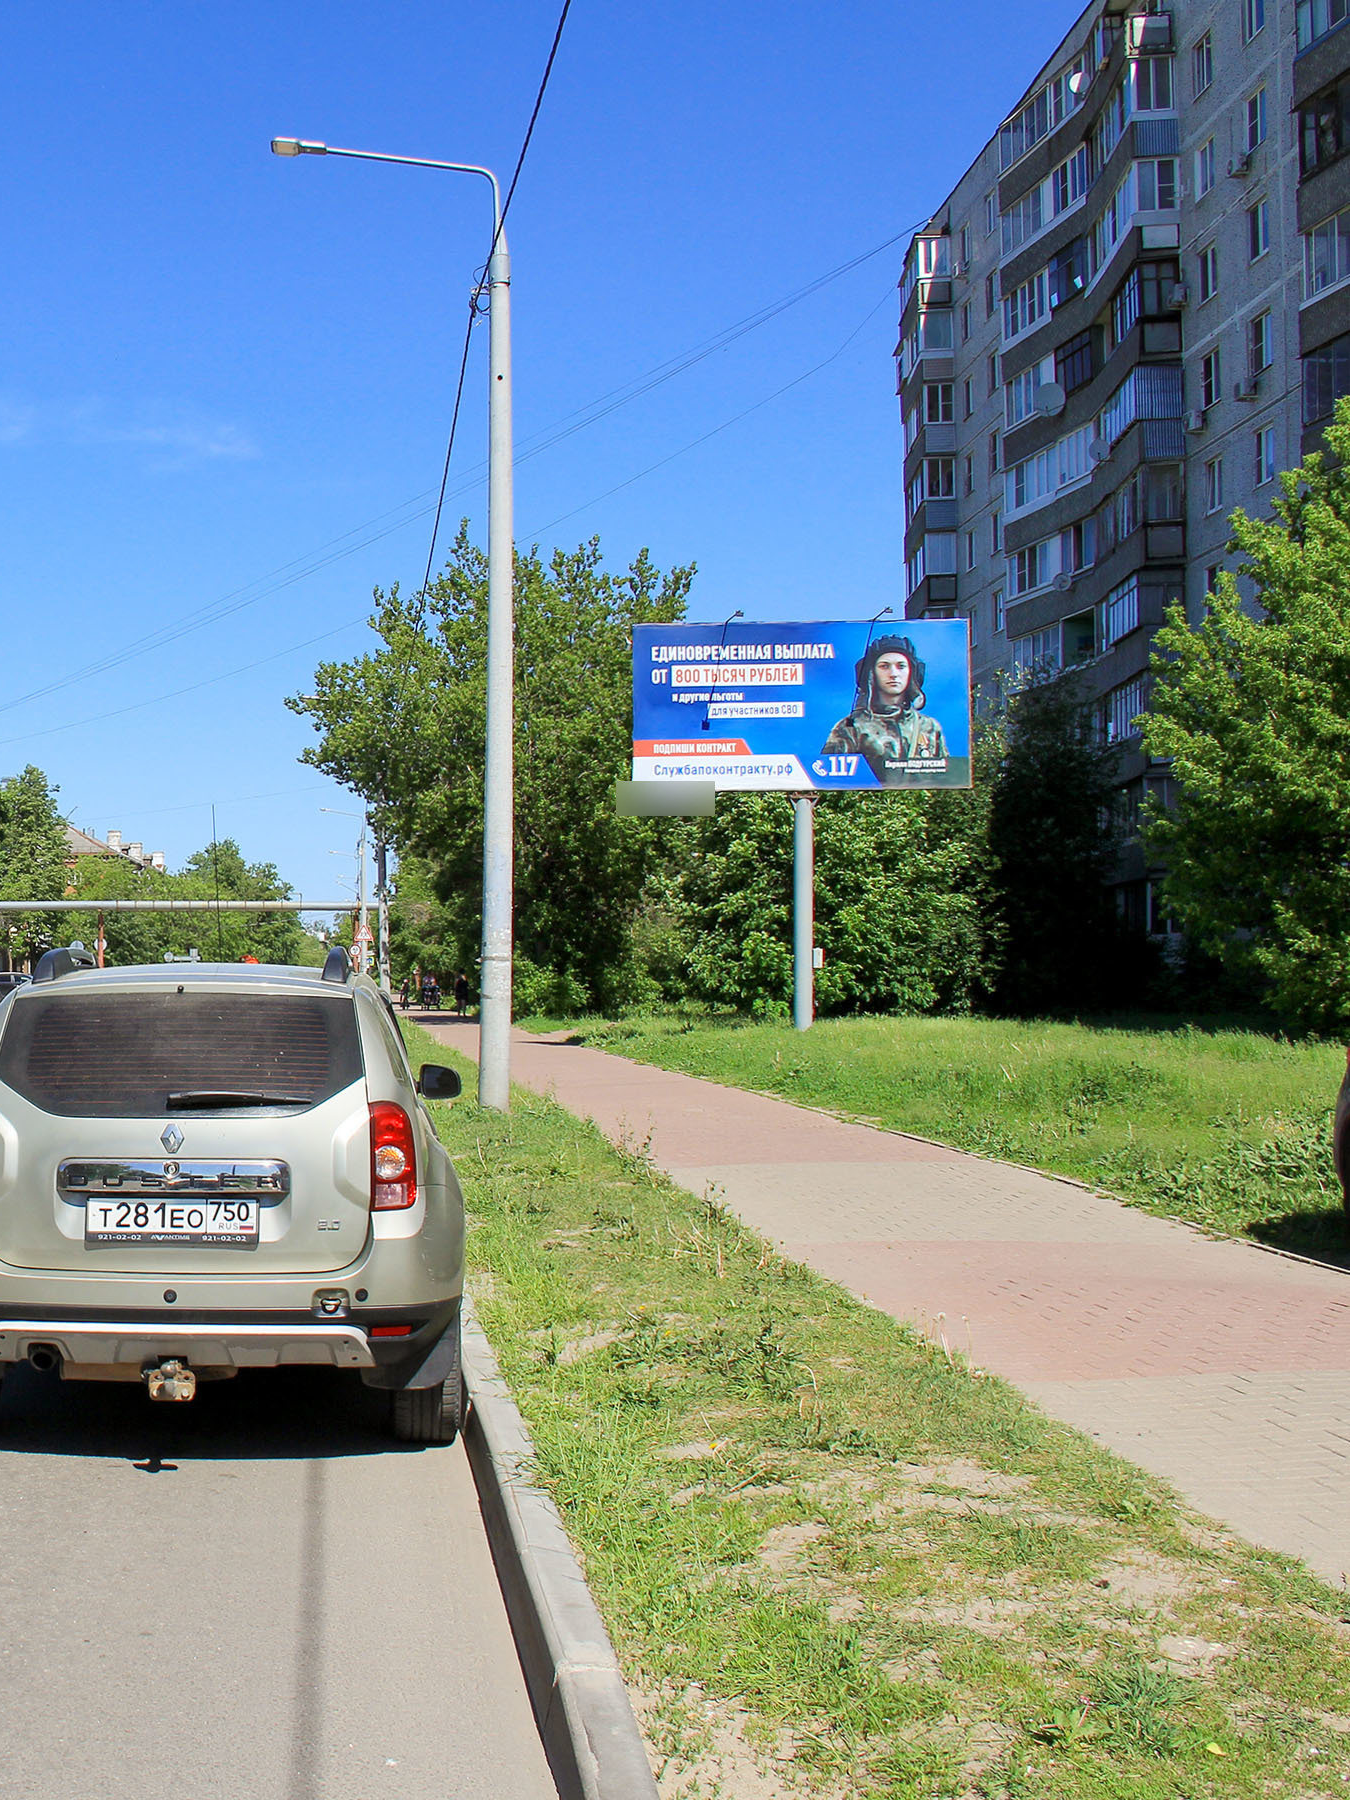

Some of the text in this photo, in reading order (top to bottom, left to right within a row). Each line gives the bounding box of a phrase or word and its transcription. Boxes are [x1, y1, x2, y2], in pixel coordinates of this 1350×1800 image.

[651, 643, 834, 663] ЕДИНОВРЕМЕННАЯ ВЫПЛАТА
[651, 665, 798, 684] ОТ 800 ТЫСЯЧ РУБЛЕЙ
[672, 692, 743, 704] и другие льготы
[711, 704, 798, 717] для участников СВО
[653, 742, 737, 755] ПОДПИШИ КОНТРАКТ
[653, 762, 793, 777] Службапоконтракту.рф
[828, 756, 859, 776] 117
[68, 1172, 282, 1190] DUSTER
[99, 1201, 250, 1228] Т281ЕО 750
[218, 1222, 239, 1231] RUS
